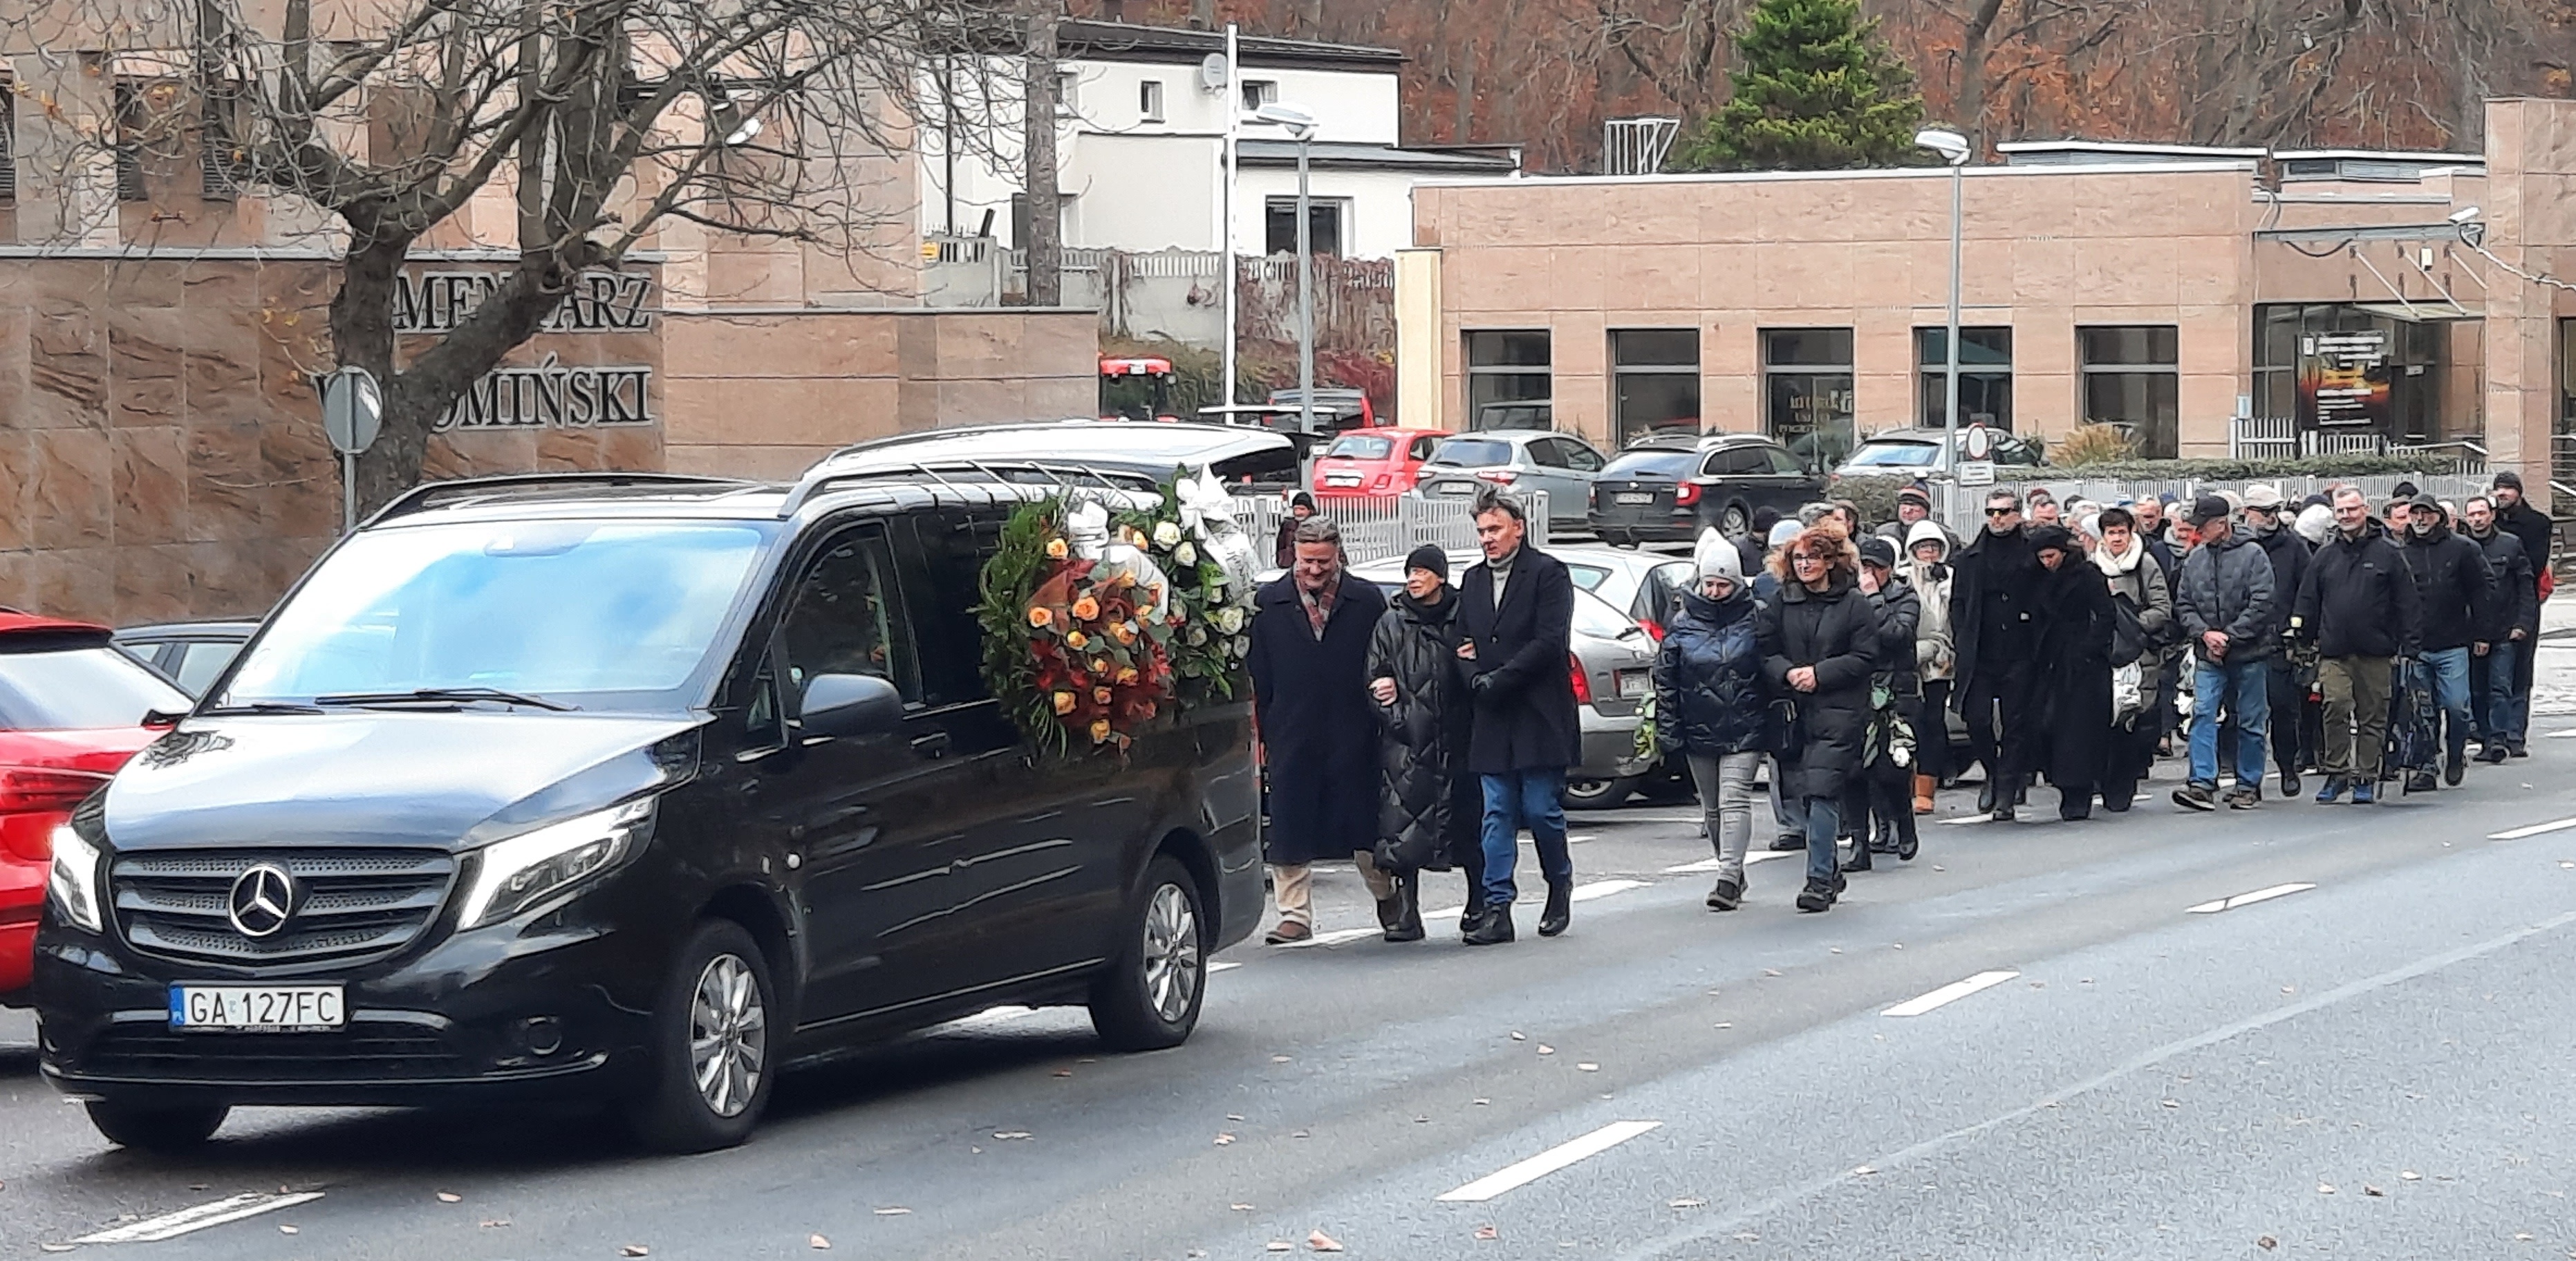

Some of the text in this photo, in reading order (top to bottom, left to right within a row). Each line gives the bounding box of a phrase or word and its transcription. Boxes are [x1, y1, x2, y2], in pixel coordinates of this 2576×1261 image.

[393, 274, 651, 330] MEARZ
[313, 354, 651, 428] MIŃSKI
[190, 991, 336, 1023] GA 127FC
